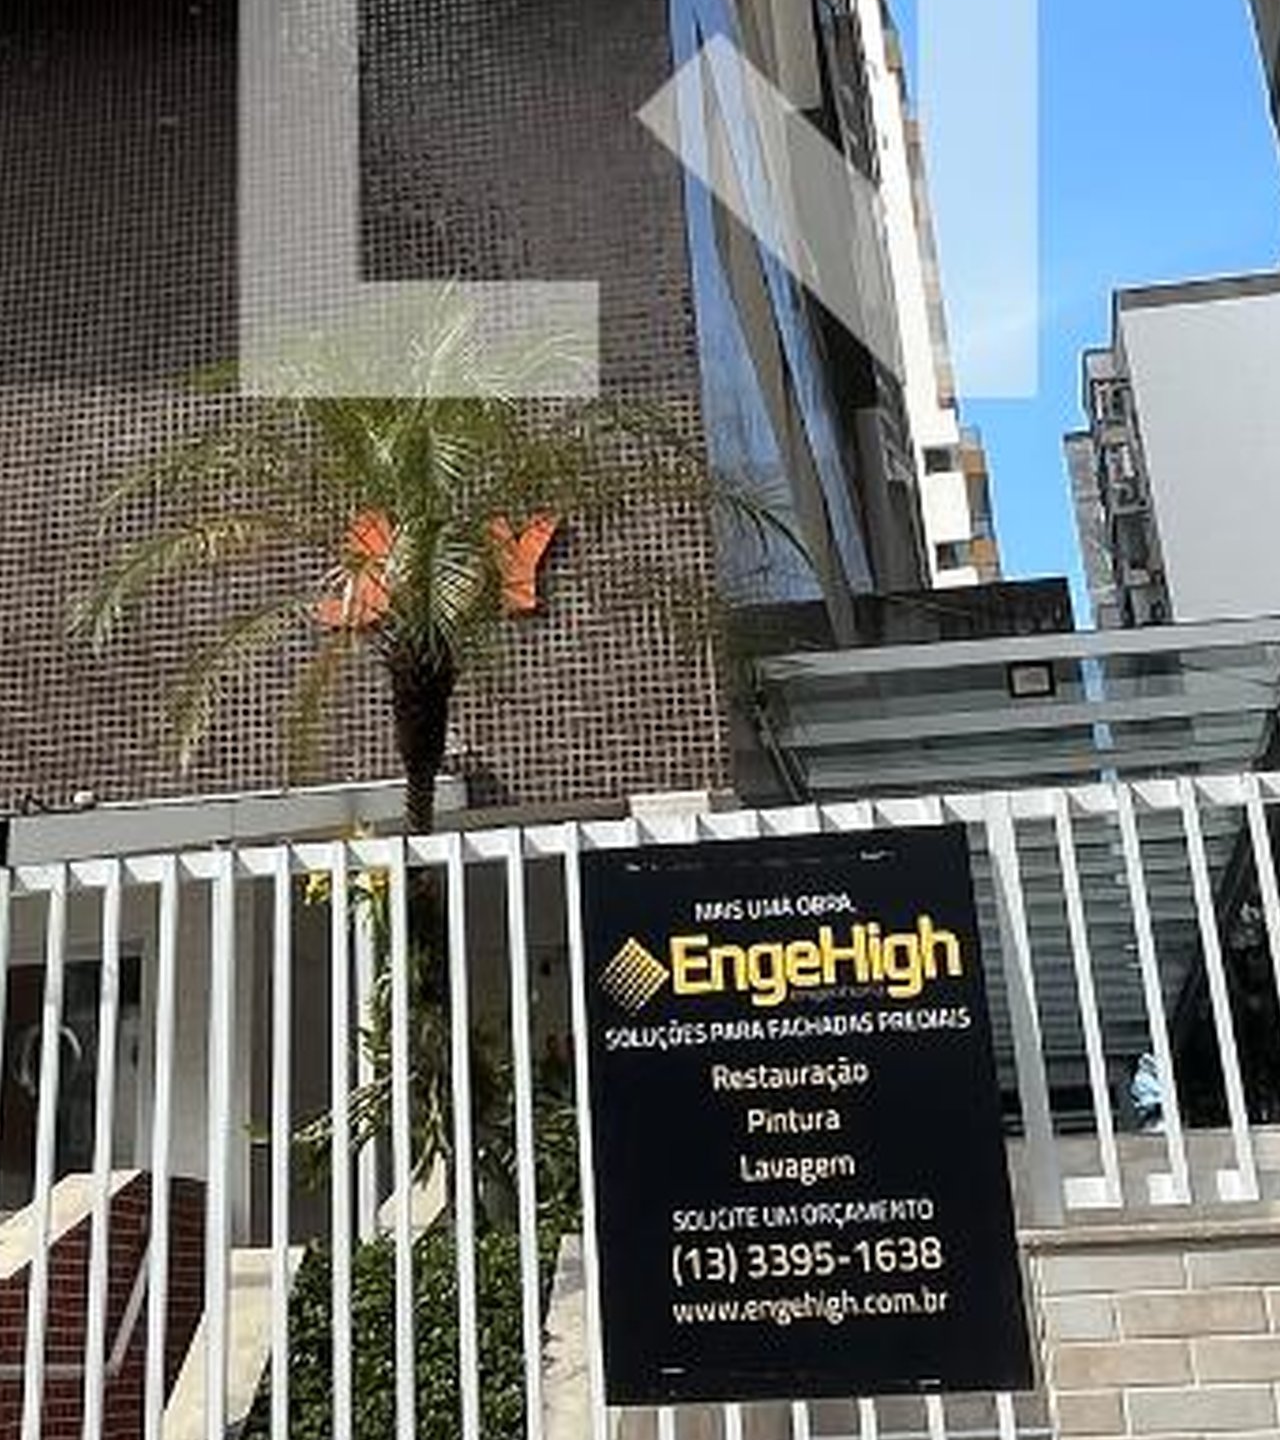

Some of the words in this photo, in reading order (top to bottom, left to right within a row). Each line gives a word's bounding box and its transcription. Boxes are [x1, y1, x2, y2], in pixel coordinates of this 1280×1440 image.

[694, 900, 744, 922] MAIS
[747, 896, 795, 919] UMA
[670, 914, 963, 1007] EngeHigh
[605, 1020, 708, 1051] SOLUÇÕES
[710, 1022, 765, 1043] PARA
[769, 1014, 873, 1040] FACHADAS
[878, 1007, 972, 1032] PREDIAIS
[712, 1056, 869, 1091] Restauração
[747, 1108, 841, 1134] Pintura
[740, 1153, 856, 1185] Lavagem
[672, 1206, 759, 1232] SOLICITE
[763, 1204, 798, 1227] UM
[801, 1198, 935, 1230] ORÇAMENTO
[672, 1241, 738, 1287] (13)
[746, 1236, 944, 1278] 3395-1638
[672, 1286, 948, 1326] www.engehigh.com.br
